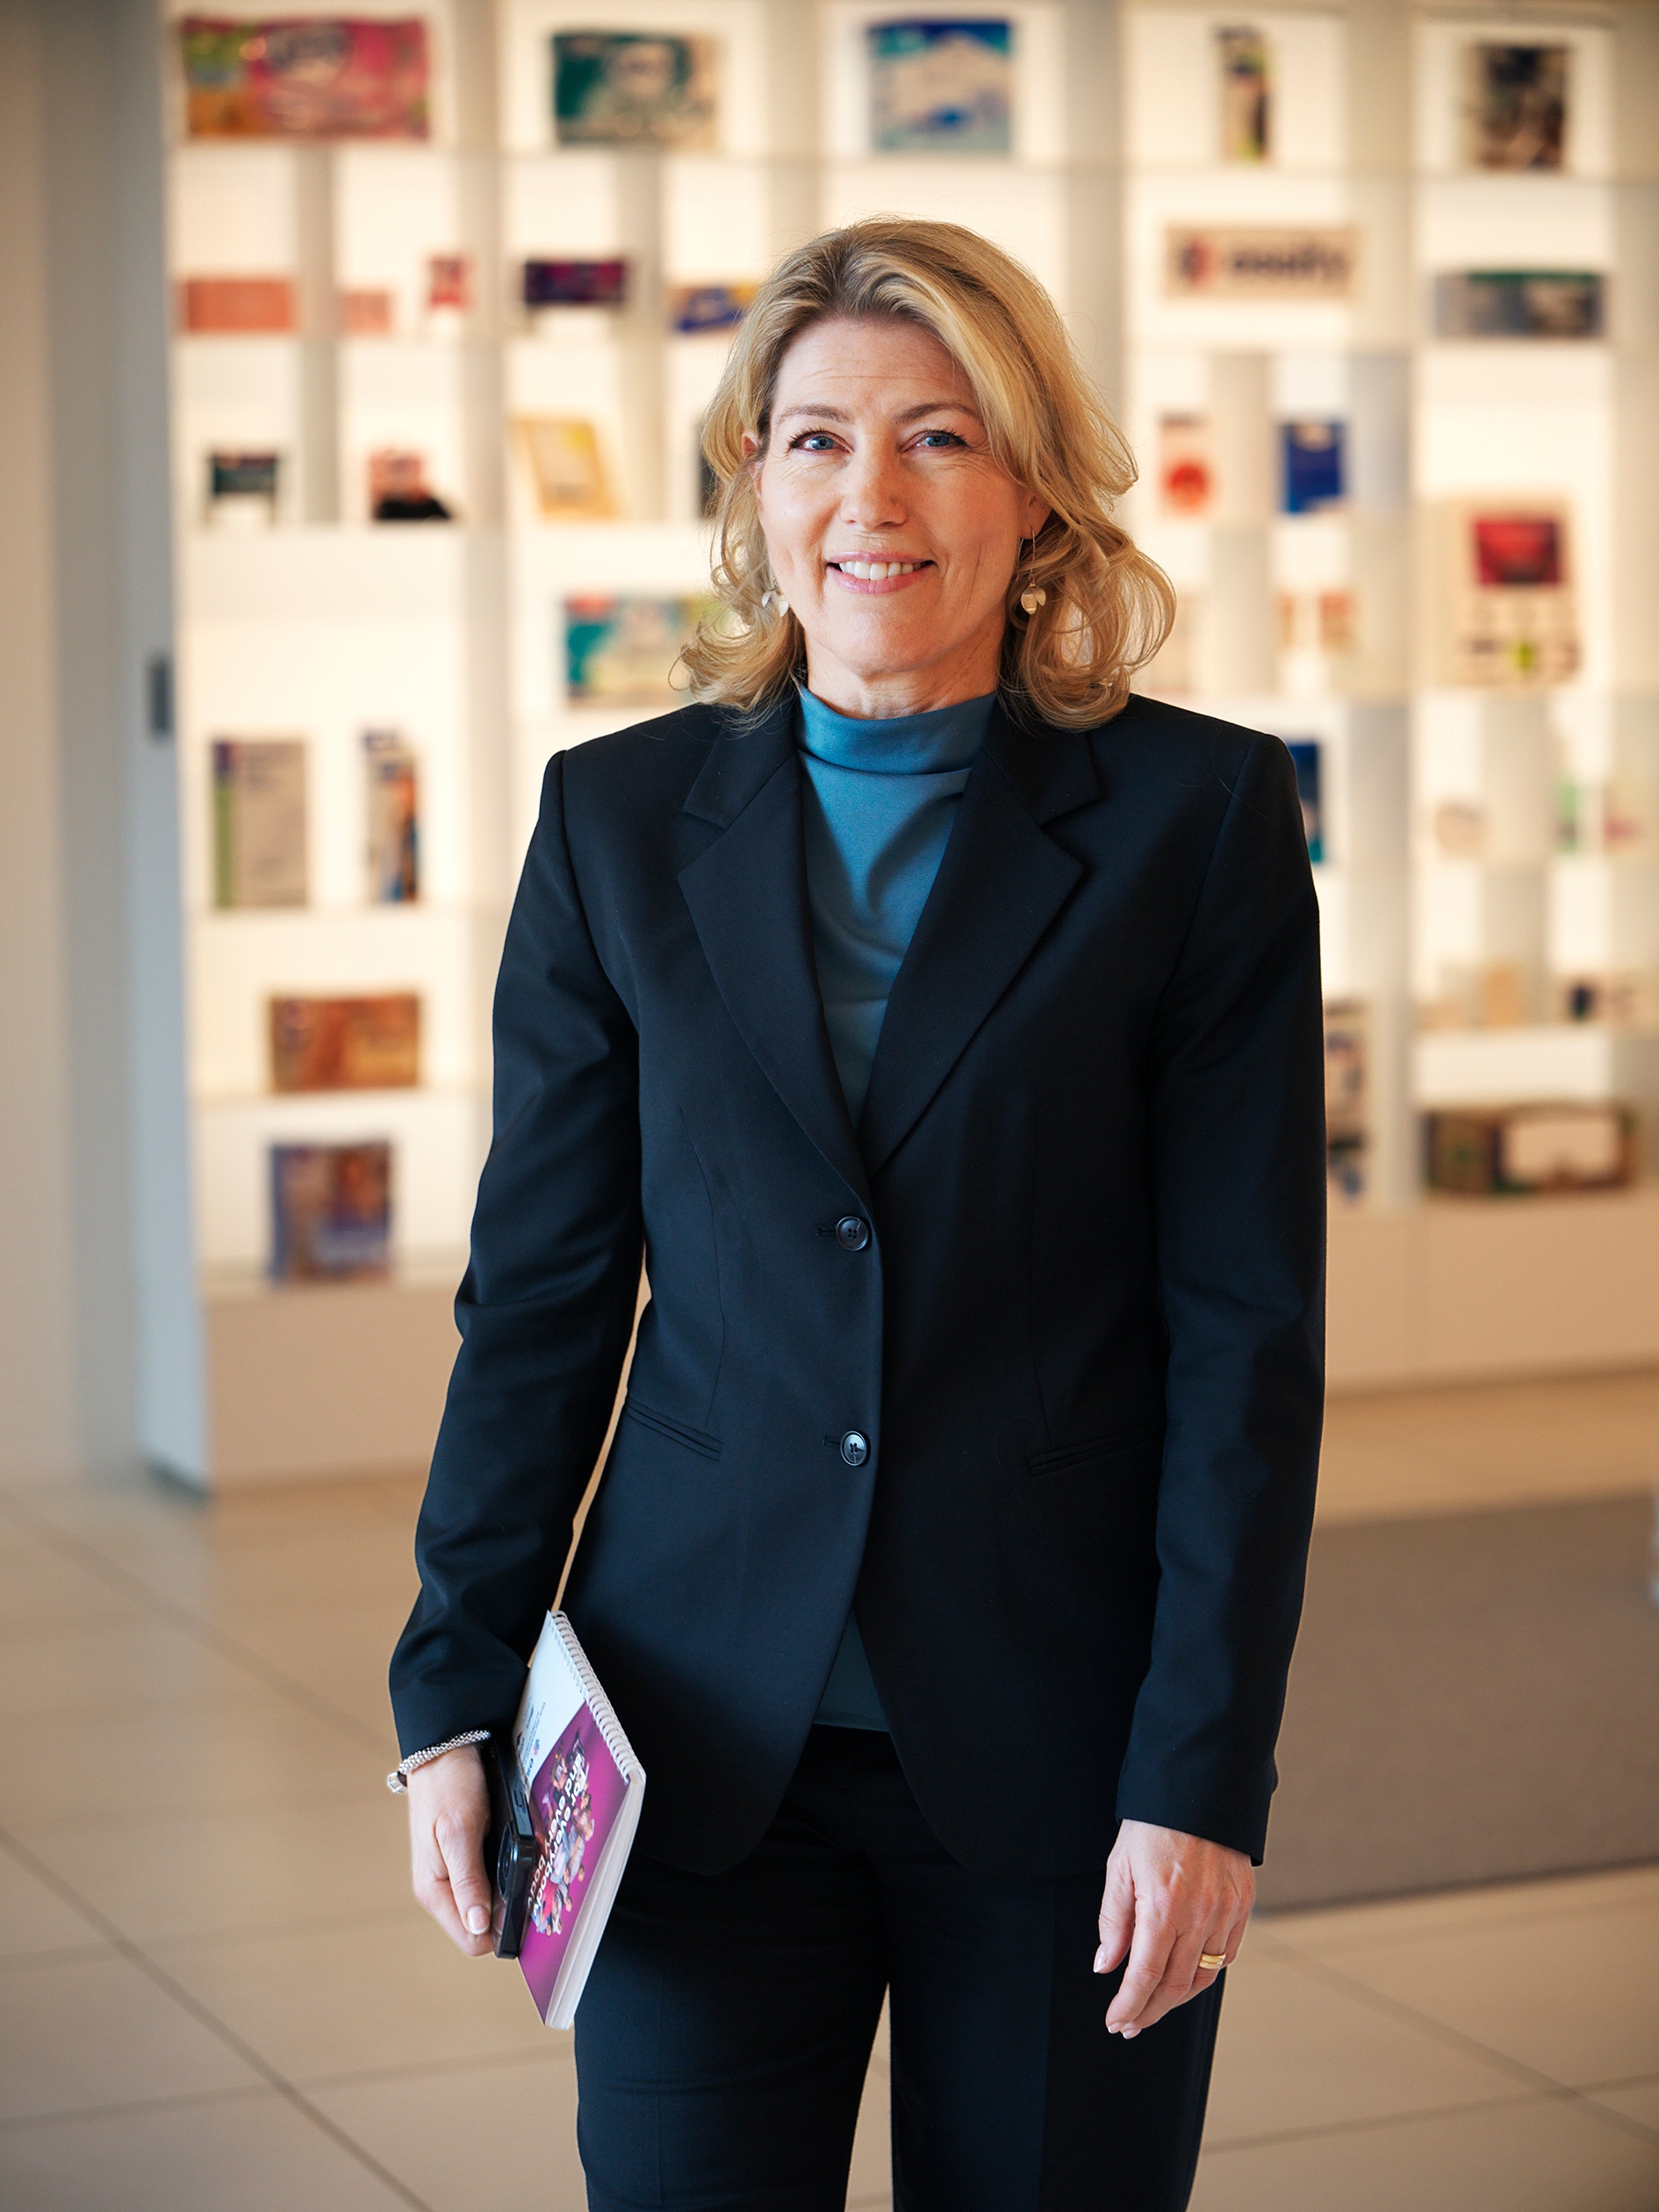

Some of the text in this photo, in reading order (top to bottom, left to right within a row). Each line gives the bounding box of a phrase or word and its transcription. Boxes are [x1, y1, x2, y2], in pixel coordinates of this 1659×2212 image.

[564, 1752, 582, 1798] and
[544, 1795, 566, 1854] every
[534, 1806, 571, 1916] everybody
